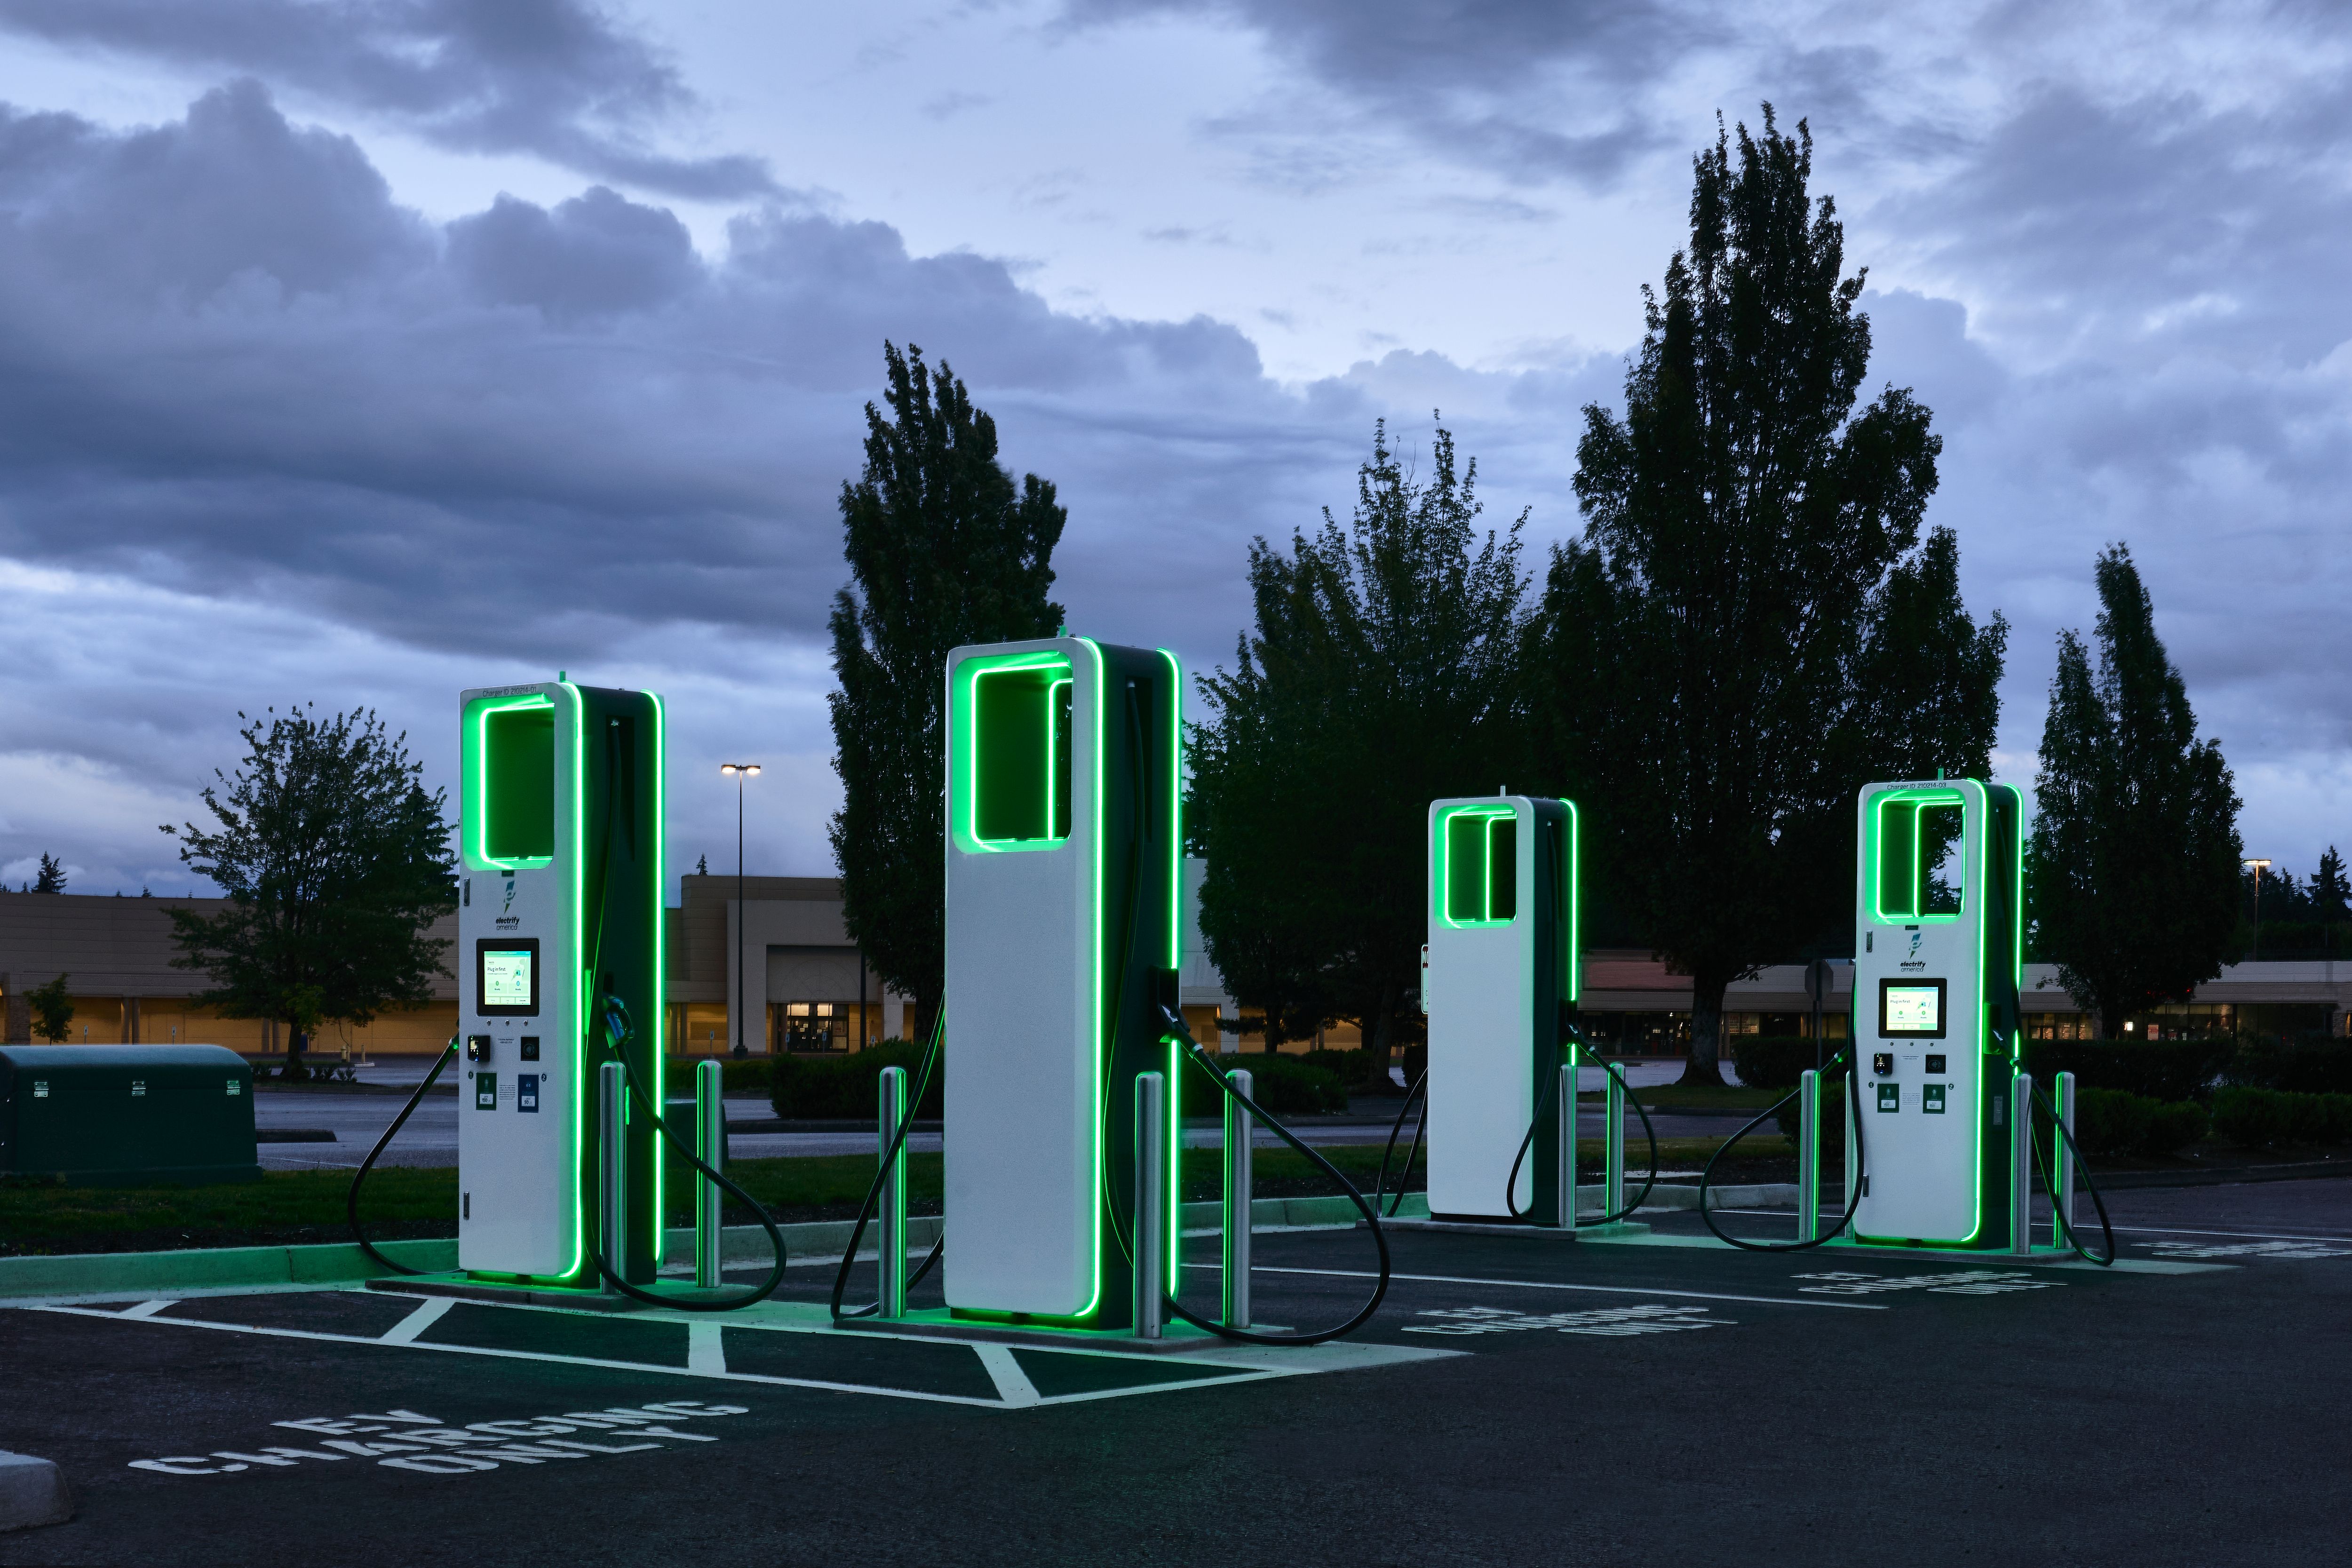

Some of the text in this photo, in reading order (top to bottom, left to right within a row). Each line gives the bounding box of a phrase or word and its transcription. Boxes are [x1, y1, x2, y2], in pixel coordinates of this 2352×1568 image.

[483, 690, 503, 698] Charger
[511, 686, 537, 695] 210214-01
[496, 916, 520, 925] electrify
[1798, 1270, 2032, 1294] CHARGING
[1926, 1280, 2069, 1295] ONLY
[1401, 1305, 1709, 1335] CHARGING
[1415, 1306, 1526, 1320] EV
[1557, 1316, 1739, 1336] ONLY
[269, 1409, 445, 1435] EV
[127, 1401, 749, 1475] CHARGING
[377, 1426, 720, 1473] ONLY
